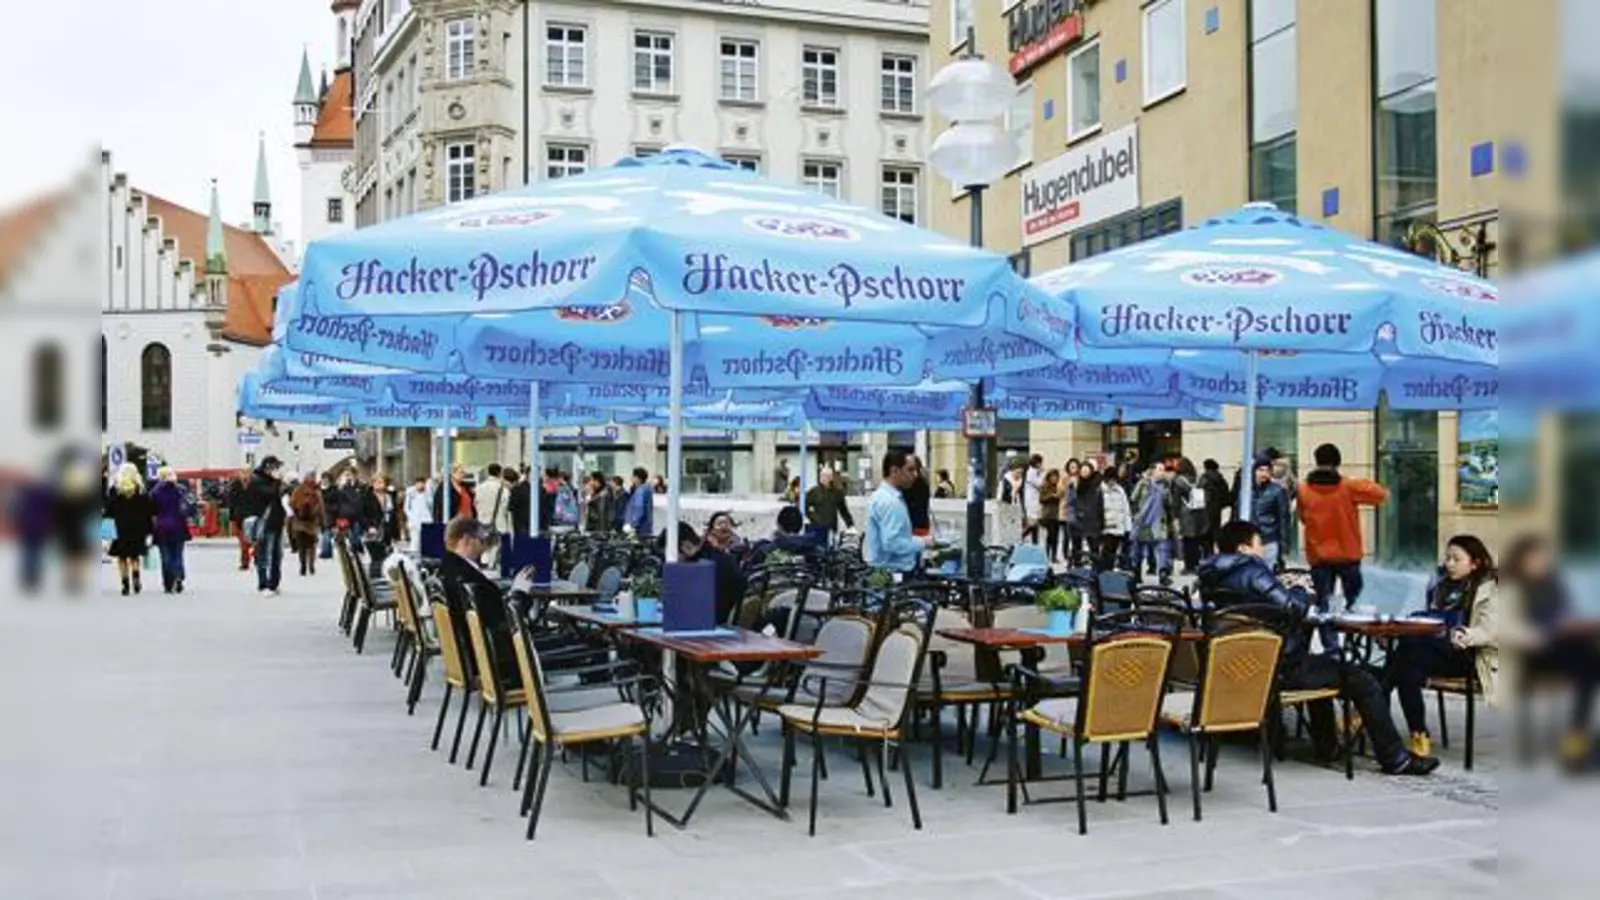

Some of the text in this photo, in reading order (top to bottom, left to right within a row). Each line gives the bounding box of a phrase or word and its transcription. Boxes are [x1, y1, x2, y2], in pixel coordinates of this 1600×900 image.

[1024, 136, 1134, 214] Hugendubel
[336, 249, 596, 301] Hacker-Pschorr
[682, 252, 966, 307] Hacker-Pschorr
[1101, 303, 1352, 342] Hacker-Pschorr
